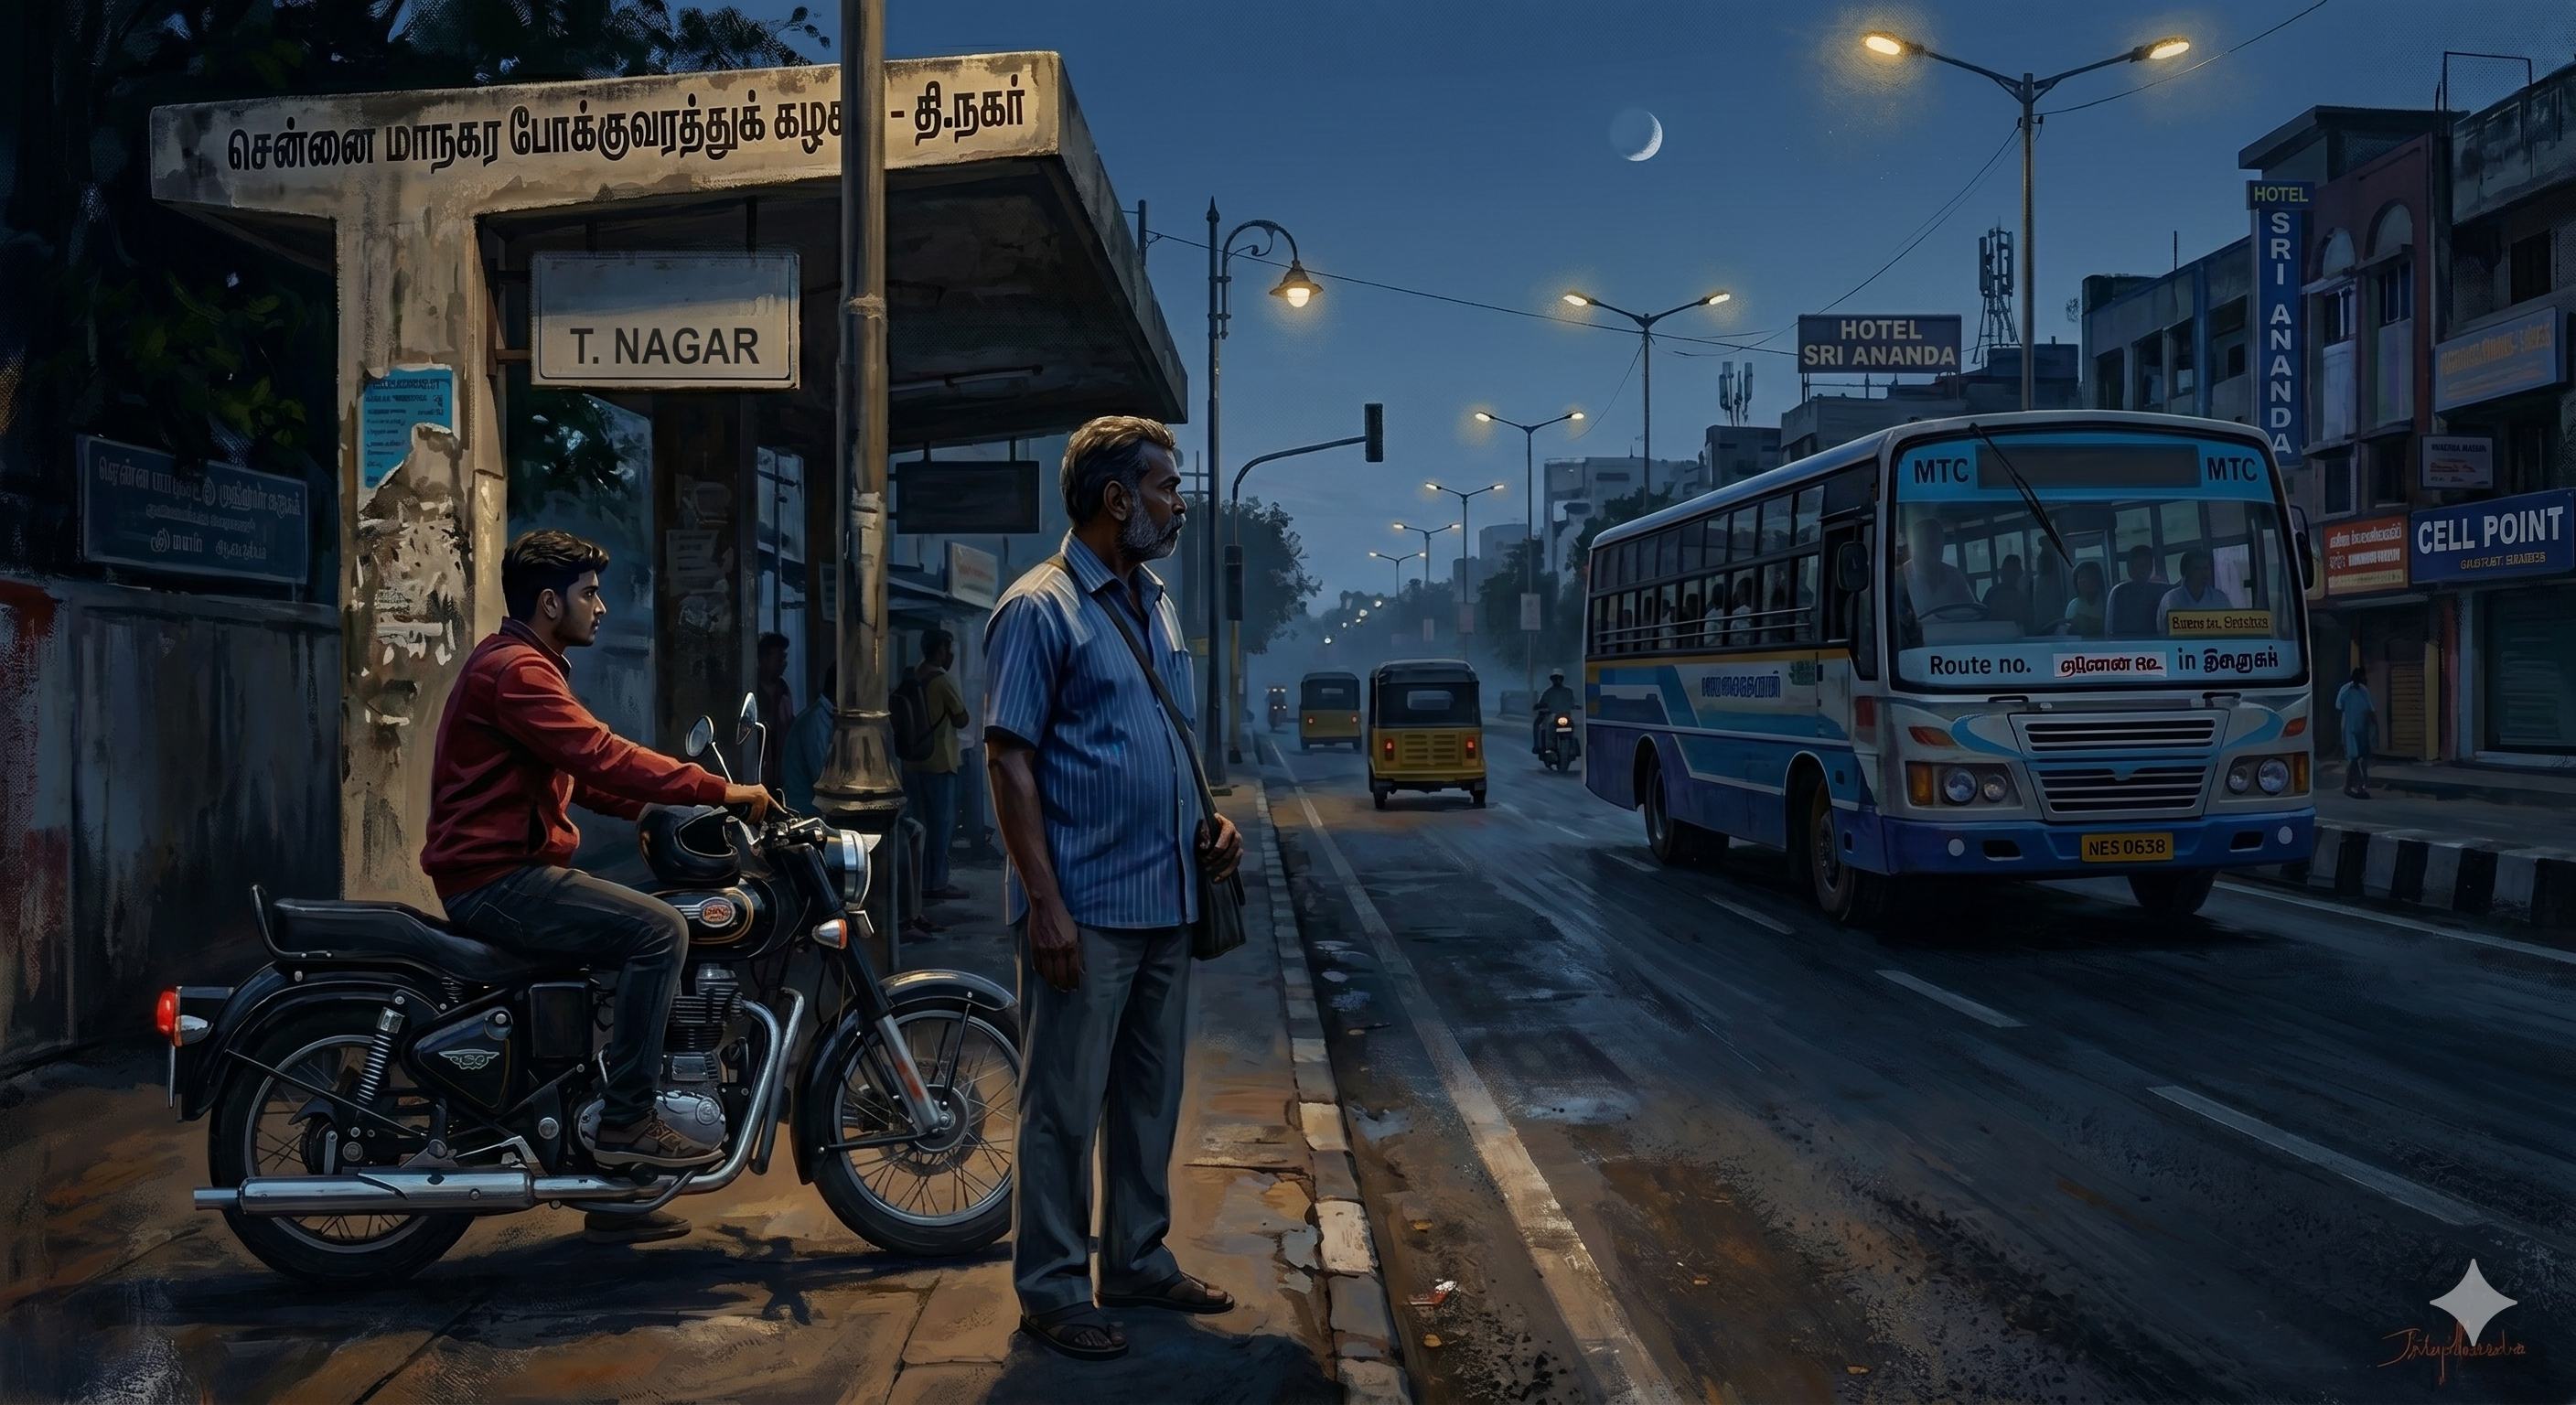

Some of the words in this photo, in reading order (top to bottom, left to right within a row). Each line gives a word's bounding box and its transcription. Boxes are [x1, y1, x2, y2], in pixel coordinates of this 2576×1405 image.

[228, 116, 374, 171] சென்னை
[385, 119, 501, 174] மாநகர
[510, 90, 766, 161] போக்குவரத்துக்
[774, 101, 842, 155] கழக
[915, 74, 1025, 145] தி.நகர்
[2254, 186, 2309, 202] HOTEL
[2270, 211, 2292, 285] SRI
[1841, 319, 1923, 339] HOTEL
[570, 327, 599, 364] T.
[615, 327, 760, 364] NAGAR
[1803, 344, 1843, 366] SRI
[1852, 345, 1956, 366] ANANDA
[2270, 303, 2292, 454] ANANDA
[1914, 457, 1970, 484] MTC
[2206, 456, 2259, 482] MTC
[2418, 518, 2475, 554] CELL
[2483, 506, 2564, 548] POINT
[1930, 654, 1992, 675] Route
[1999, 656, 2032, 675] no.
[2178, 647, 2195, 670] in
[2088, 840, 2120, 856] NES
[2123, 839, 2166, 854] 0638
